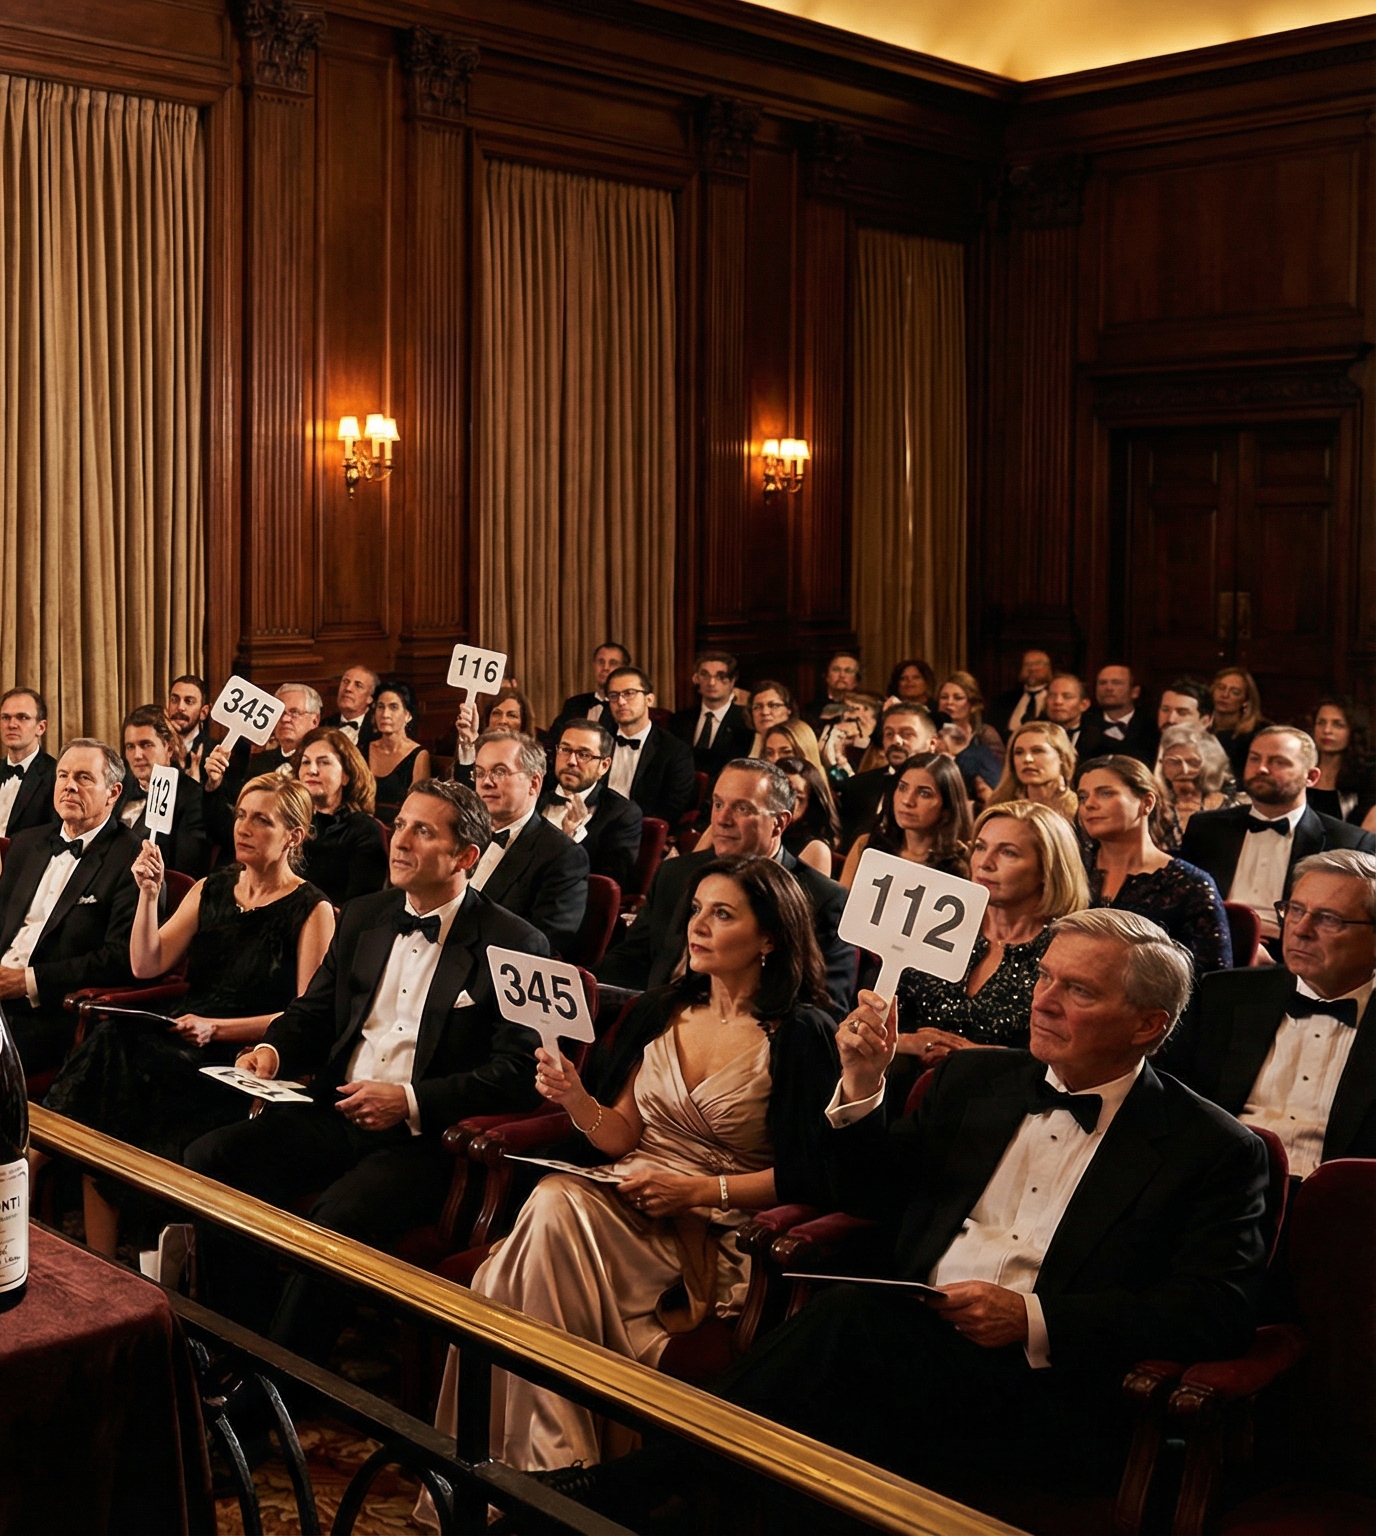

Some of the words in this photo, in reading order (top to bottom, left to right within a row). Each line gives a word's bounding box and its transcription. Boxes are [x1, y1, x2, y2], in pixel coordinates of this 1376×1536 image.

[458, 654, 499, 683] 116
[223, 688, 275, 730] 345
[149, 776, 170, 817] 112
[869, 873, 965, 954] 112
[500, 963, 578, 1021] 345
